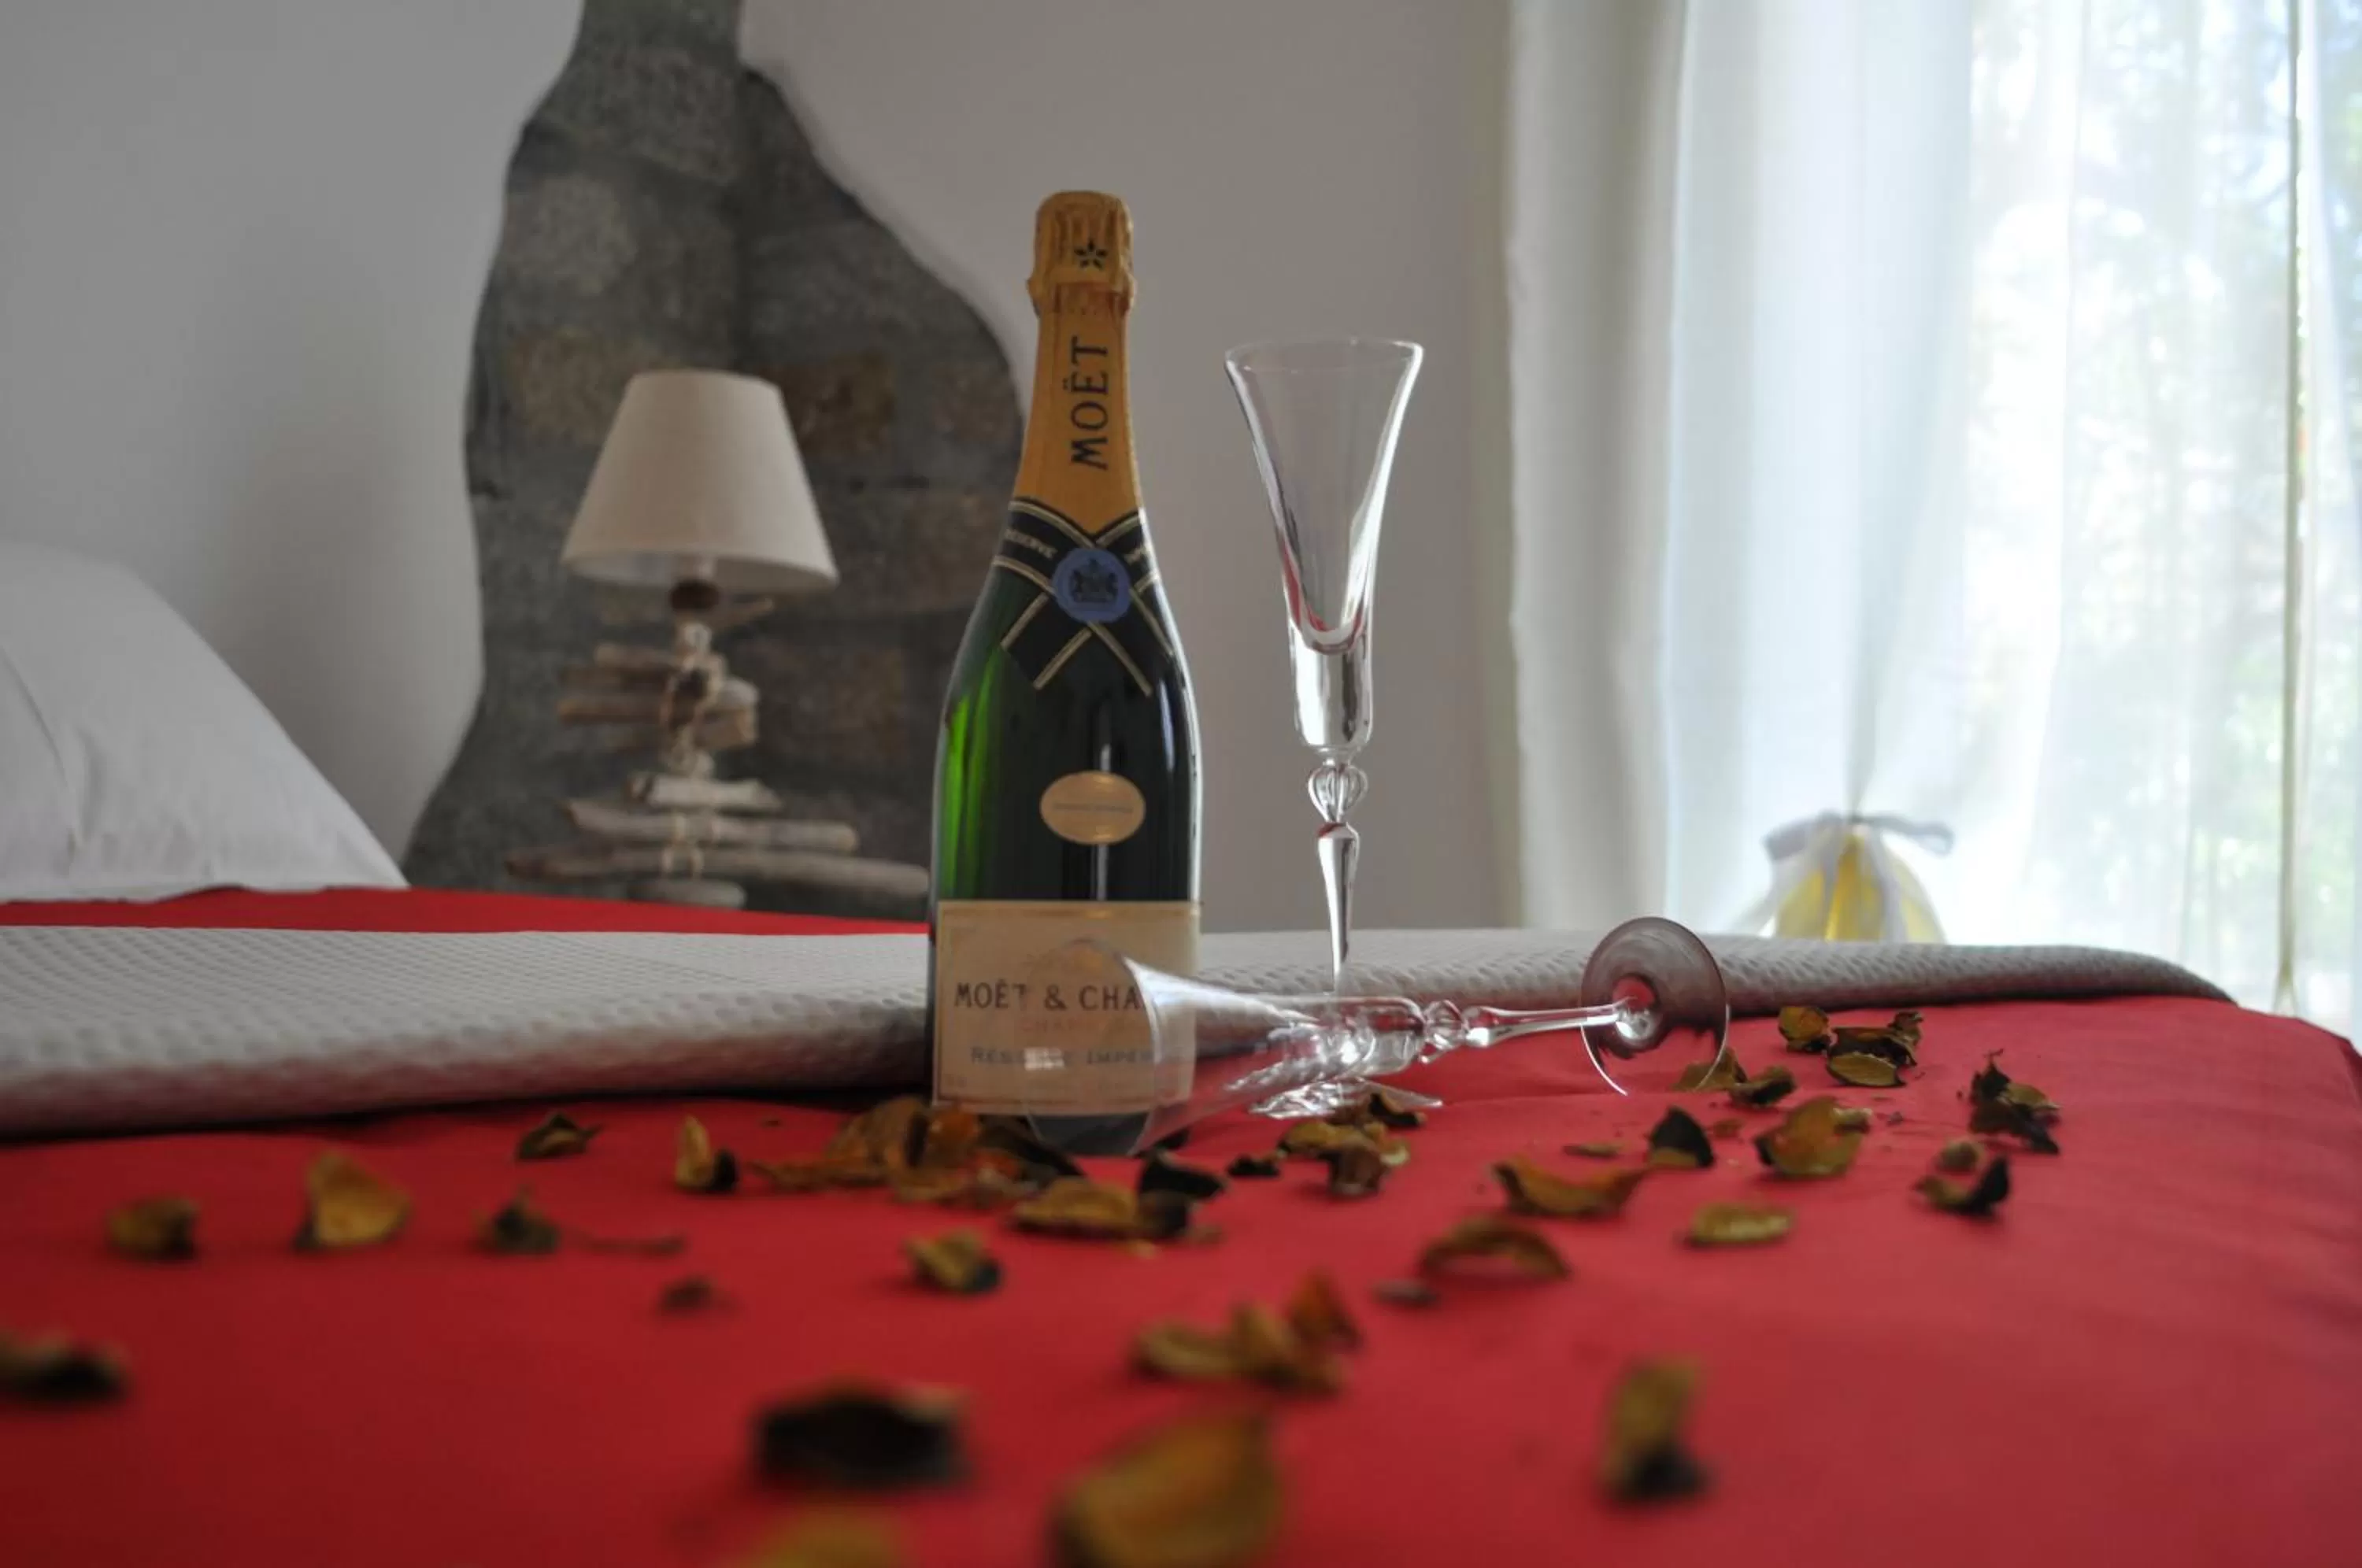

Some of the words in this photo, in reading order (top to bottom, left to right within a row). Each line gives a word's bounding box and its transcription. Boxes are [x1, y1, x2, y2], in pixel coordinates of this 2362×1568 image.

[1061, 335, 1109, 471] MOËT
[1043, 984, 1068, 1011] &
[1077, 984, 1142, 1011] CHA
